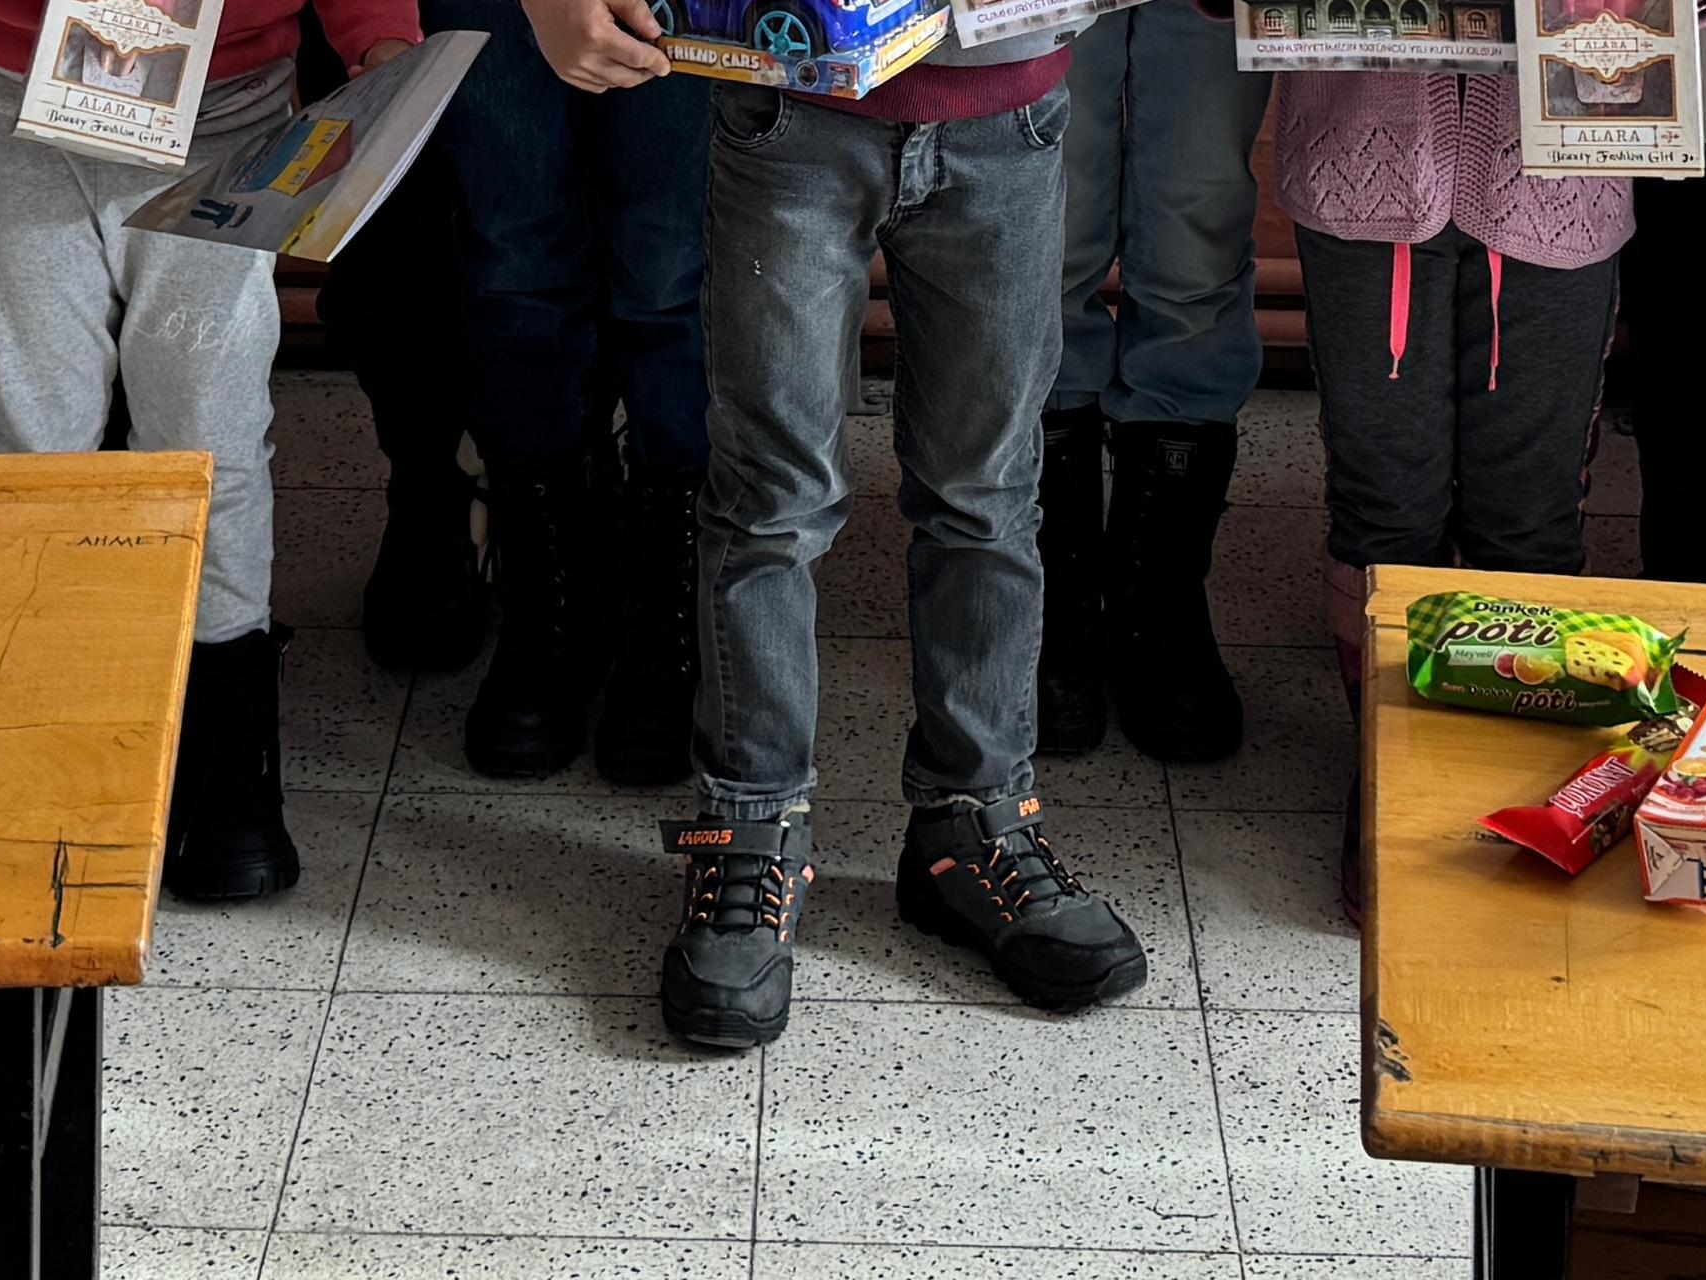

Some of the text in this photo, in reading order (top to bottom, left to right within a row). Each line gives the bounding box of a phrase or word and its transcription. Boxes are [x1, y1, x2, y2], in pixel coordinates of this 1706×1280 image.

[666, 45, 760, 72] FRIEND CARS
[78, 95, 139, 122] ALARA
[1578, 128, 1641, 144] ALARA
[1549, 149, 1675, 165] Beauty Fashion Girl
[1473, 601, 1553, 617] Dankek
[1435, 616, 1560, 653] pöti
[1468, 683, 1578, 715] Dankek pöti
